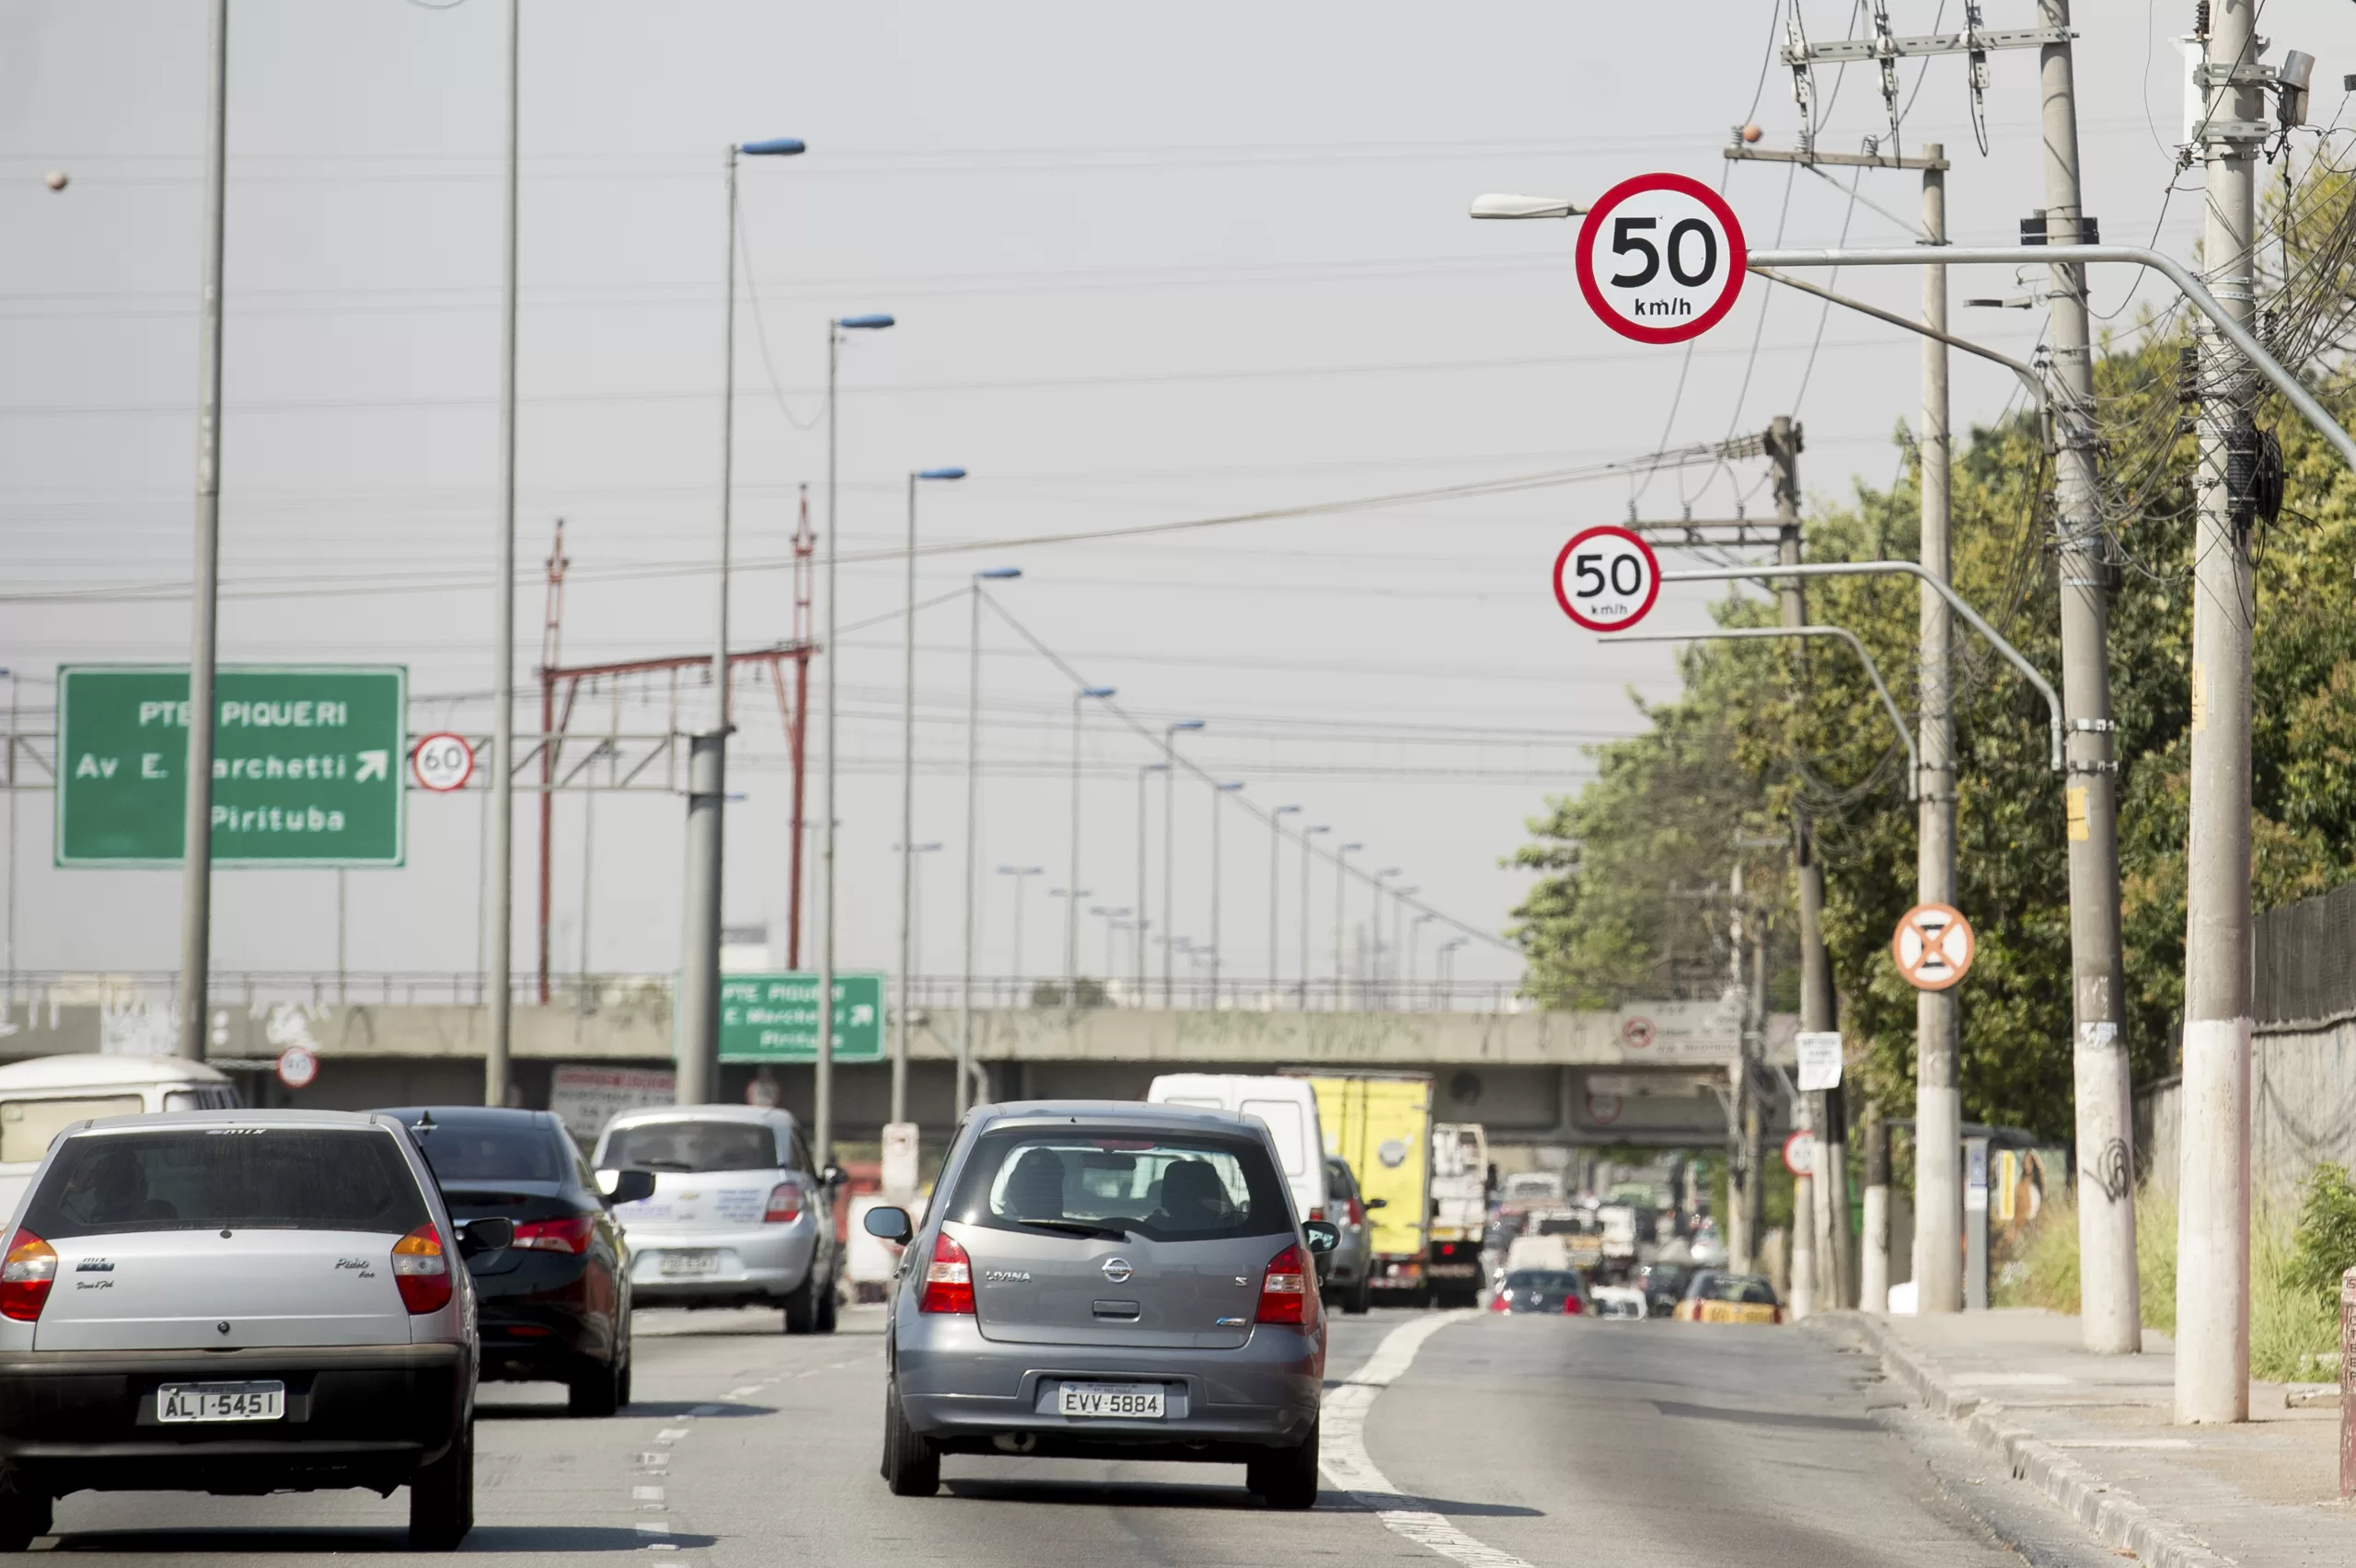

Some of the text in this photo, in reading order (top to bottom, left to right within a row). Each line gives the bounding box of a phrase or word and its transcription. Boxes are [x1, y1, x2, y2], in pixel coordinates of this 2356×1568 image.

[1610, 217, 1717, 289] 50
[1634, 297, 1692, 316] km/h
[1576, 553, 1642, 598] 50
[1590, 604, 1628, 616] km/h
[220, 700, 348, 728] PIQUERI
[75, 752, 347, 780] Av E. archetti
[424, 745, 463, 771] 60
[210, 804, 345, 832] Pirituba
[759, 1029, 845, 1049] Piritua
[986, 1271, 1032, 1283] LIVINA
